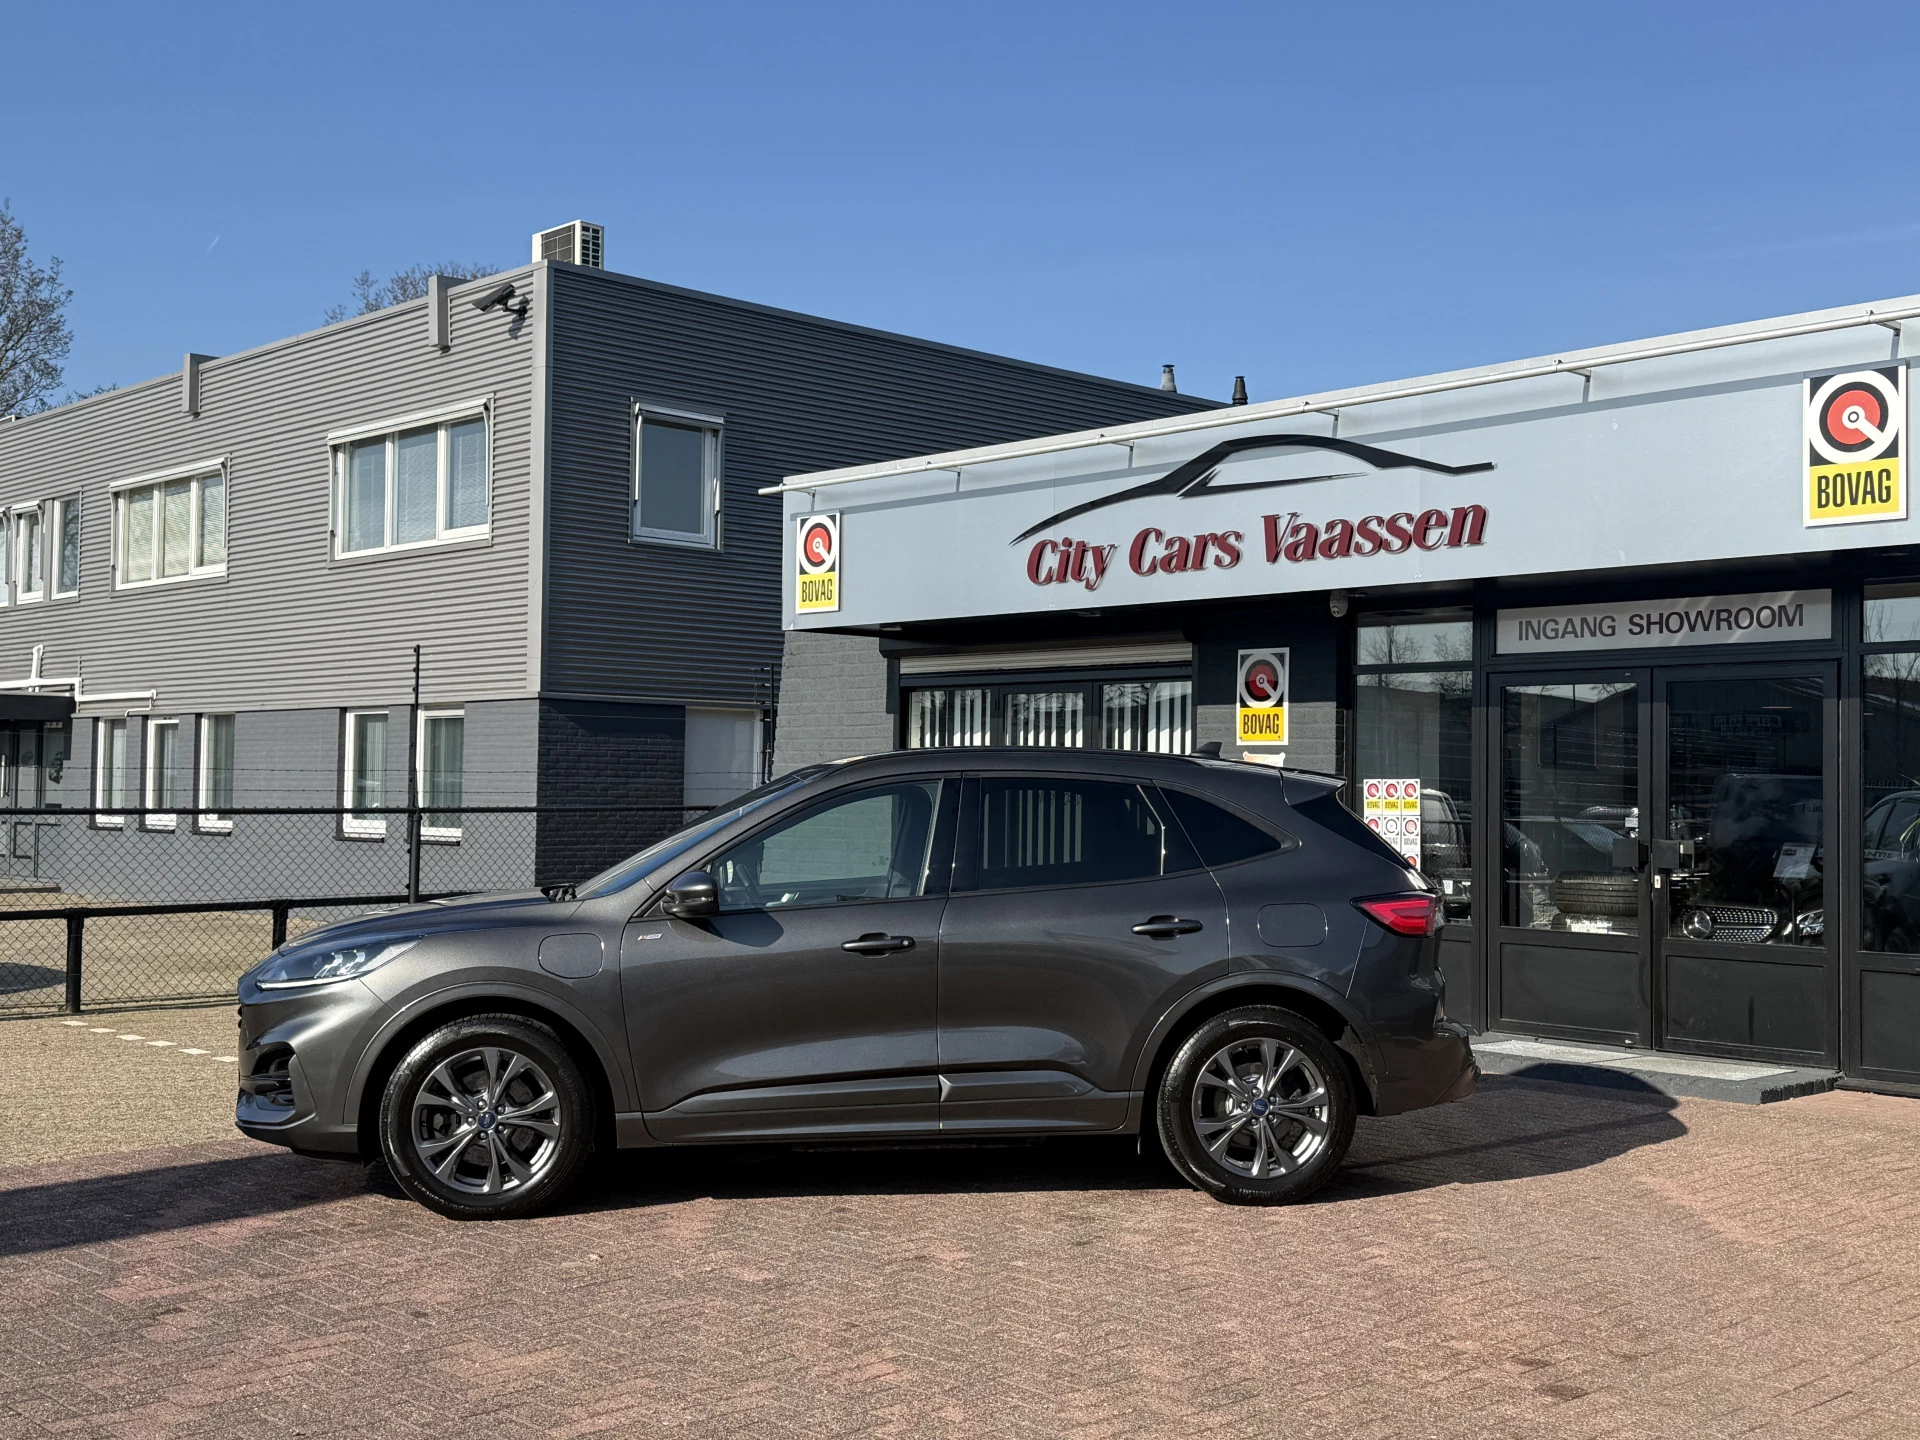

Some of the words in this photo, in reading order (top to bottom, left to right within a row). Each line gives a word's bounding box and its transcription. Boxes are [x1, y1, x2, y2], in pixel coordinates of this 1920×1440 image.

[1817, 468, 1892, 509] BOVAG
[1027, 536, 1119, 592] City
[1128, 527, 1245, 577] Cars
[1260, 503, 1489, 565] Vaassen
[801, 578, 833, 603] BOVAG
[1517, 615, 1617, 642] INGANG
[1627, 603, 1804, 636] SHOWROOM
[1242, 713, 1280, 735] BOVAG
[1384, 801, 1399, 809] BOVAG
